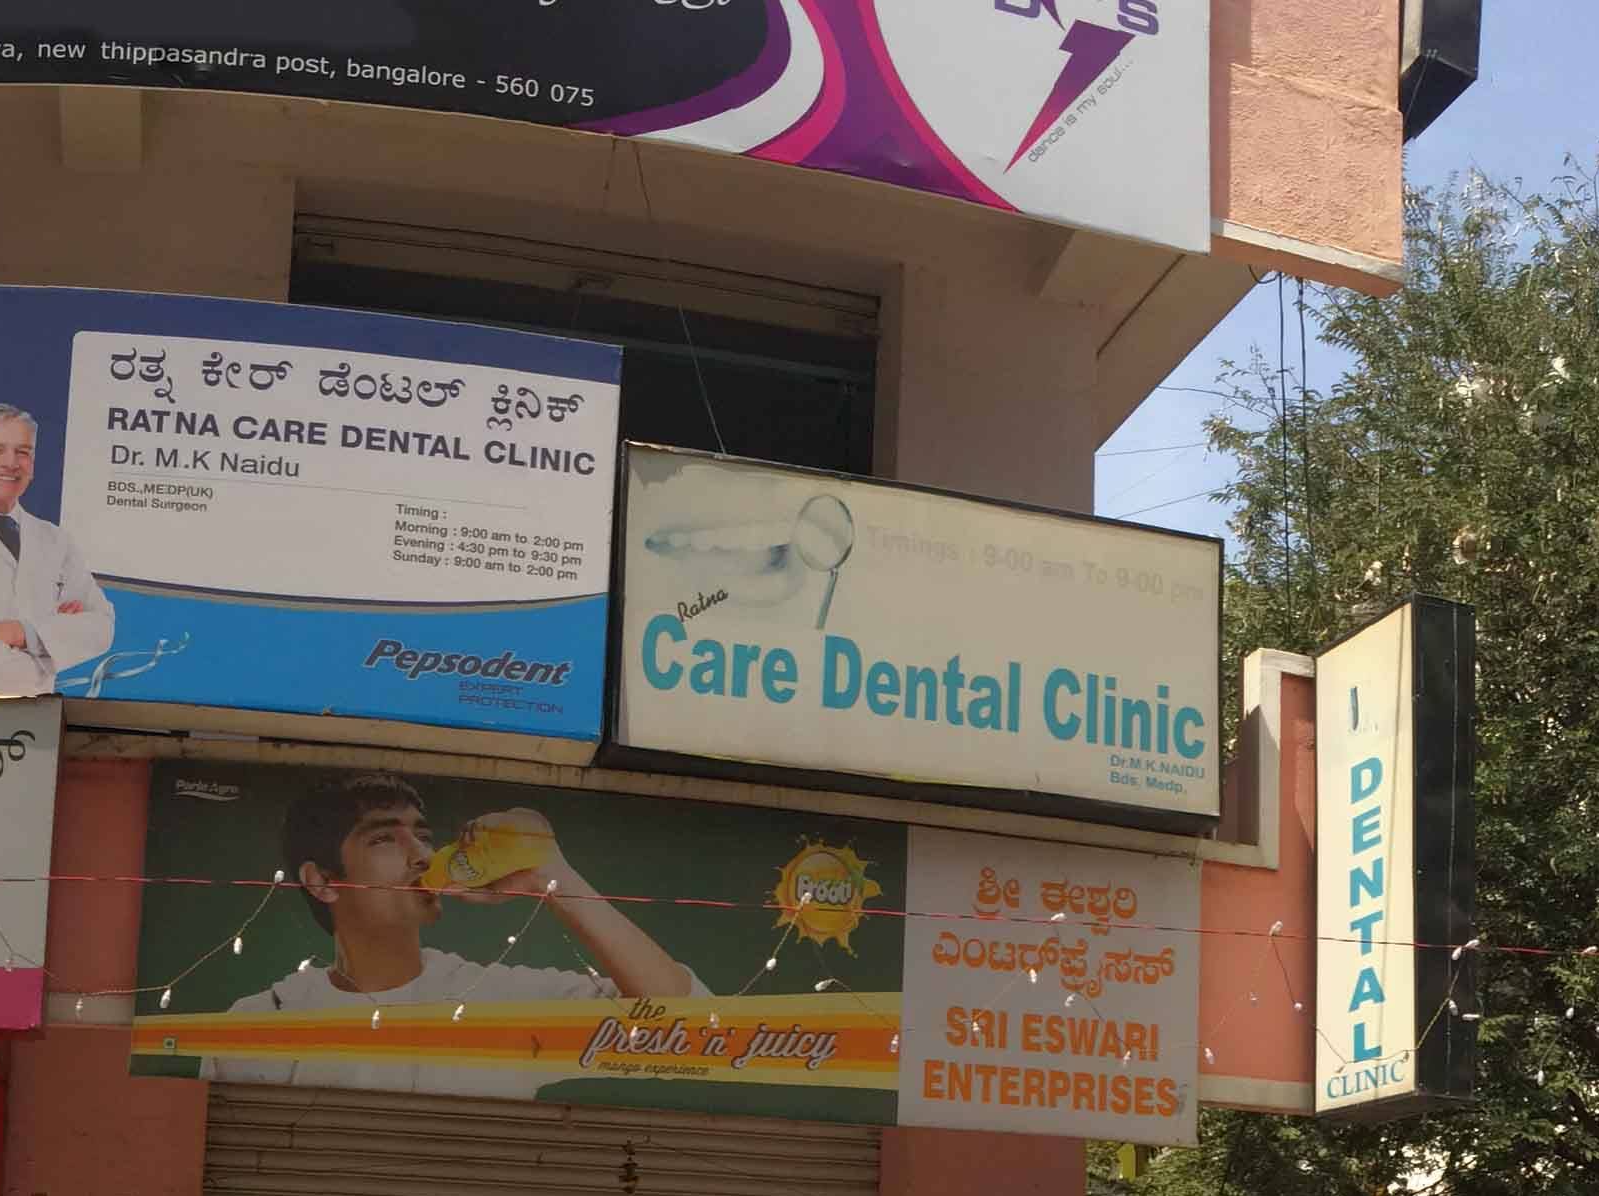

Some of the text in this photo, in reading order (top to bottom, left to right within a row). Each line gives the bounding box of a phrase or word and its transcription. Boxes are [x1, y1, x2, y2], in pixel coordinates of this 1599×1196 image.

[38, 41, 86, 60] new
[275, 52, 336, 80] post,
[347, 58, 466, 89] bangalore
[496, 75, 540, 98] 560
[550, 83, 595, 107] 075
[110, 347, 586, 432] ರತ್ನ ಕೇರ್ ಡೆಂಟಲ್ ಕ್ಲಿನಿಕ್
[107, 407, 597, 476] RATNA CARE DENTAL CLINIC
[111, 444, 145, 467] Dr.
[220, 452, 301, 478] Naidu
[106, 495, 148, 510] Dental
[393, 535, 582, 567] Evening 4:30 pm to 9:30 pm
[394, 520, 585, 552] Morning 9:00 am to 2:00 pm
[392, 550, 578, 581] Sunday 9:00 am to 2:00 pm
[676, 588, 729, 623] Ratna
[363, 639, 573, 687] Pepsodent
[642, 613, 1207, 761] Care Dental Clinic
[628, 996, 667, 1022] the
[579, 1014, 837, 1071] fresh juicy
[946, 1005, 1160, 1063] SRI ESWARI
[922, 1058, 1181, 1119] ENTERPRISES
[1326, 1058, 1407, 1100] CLINIC
